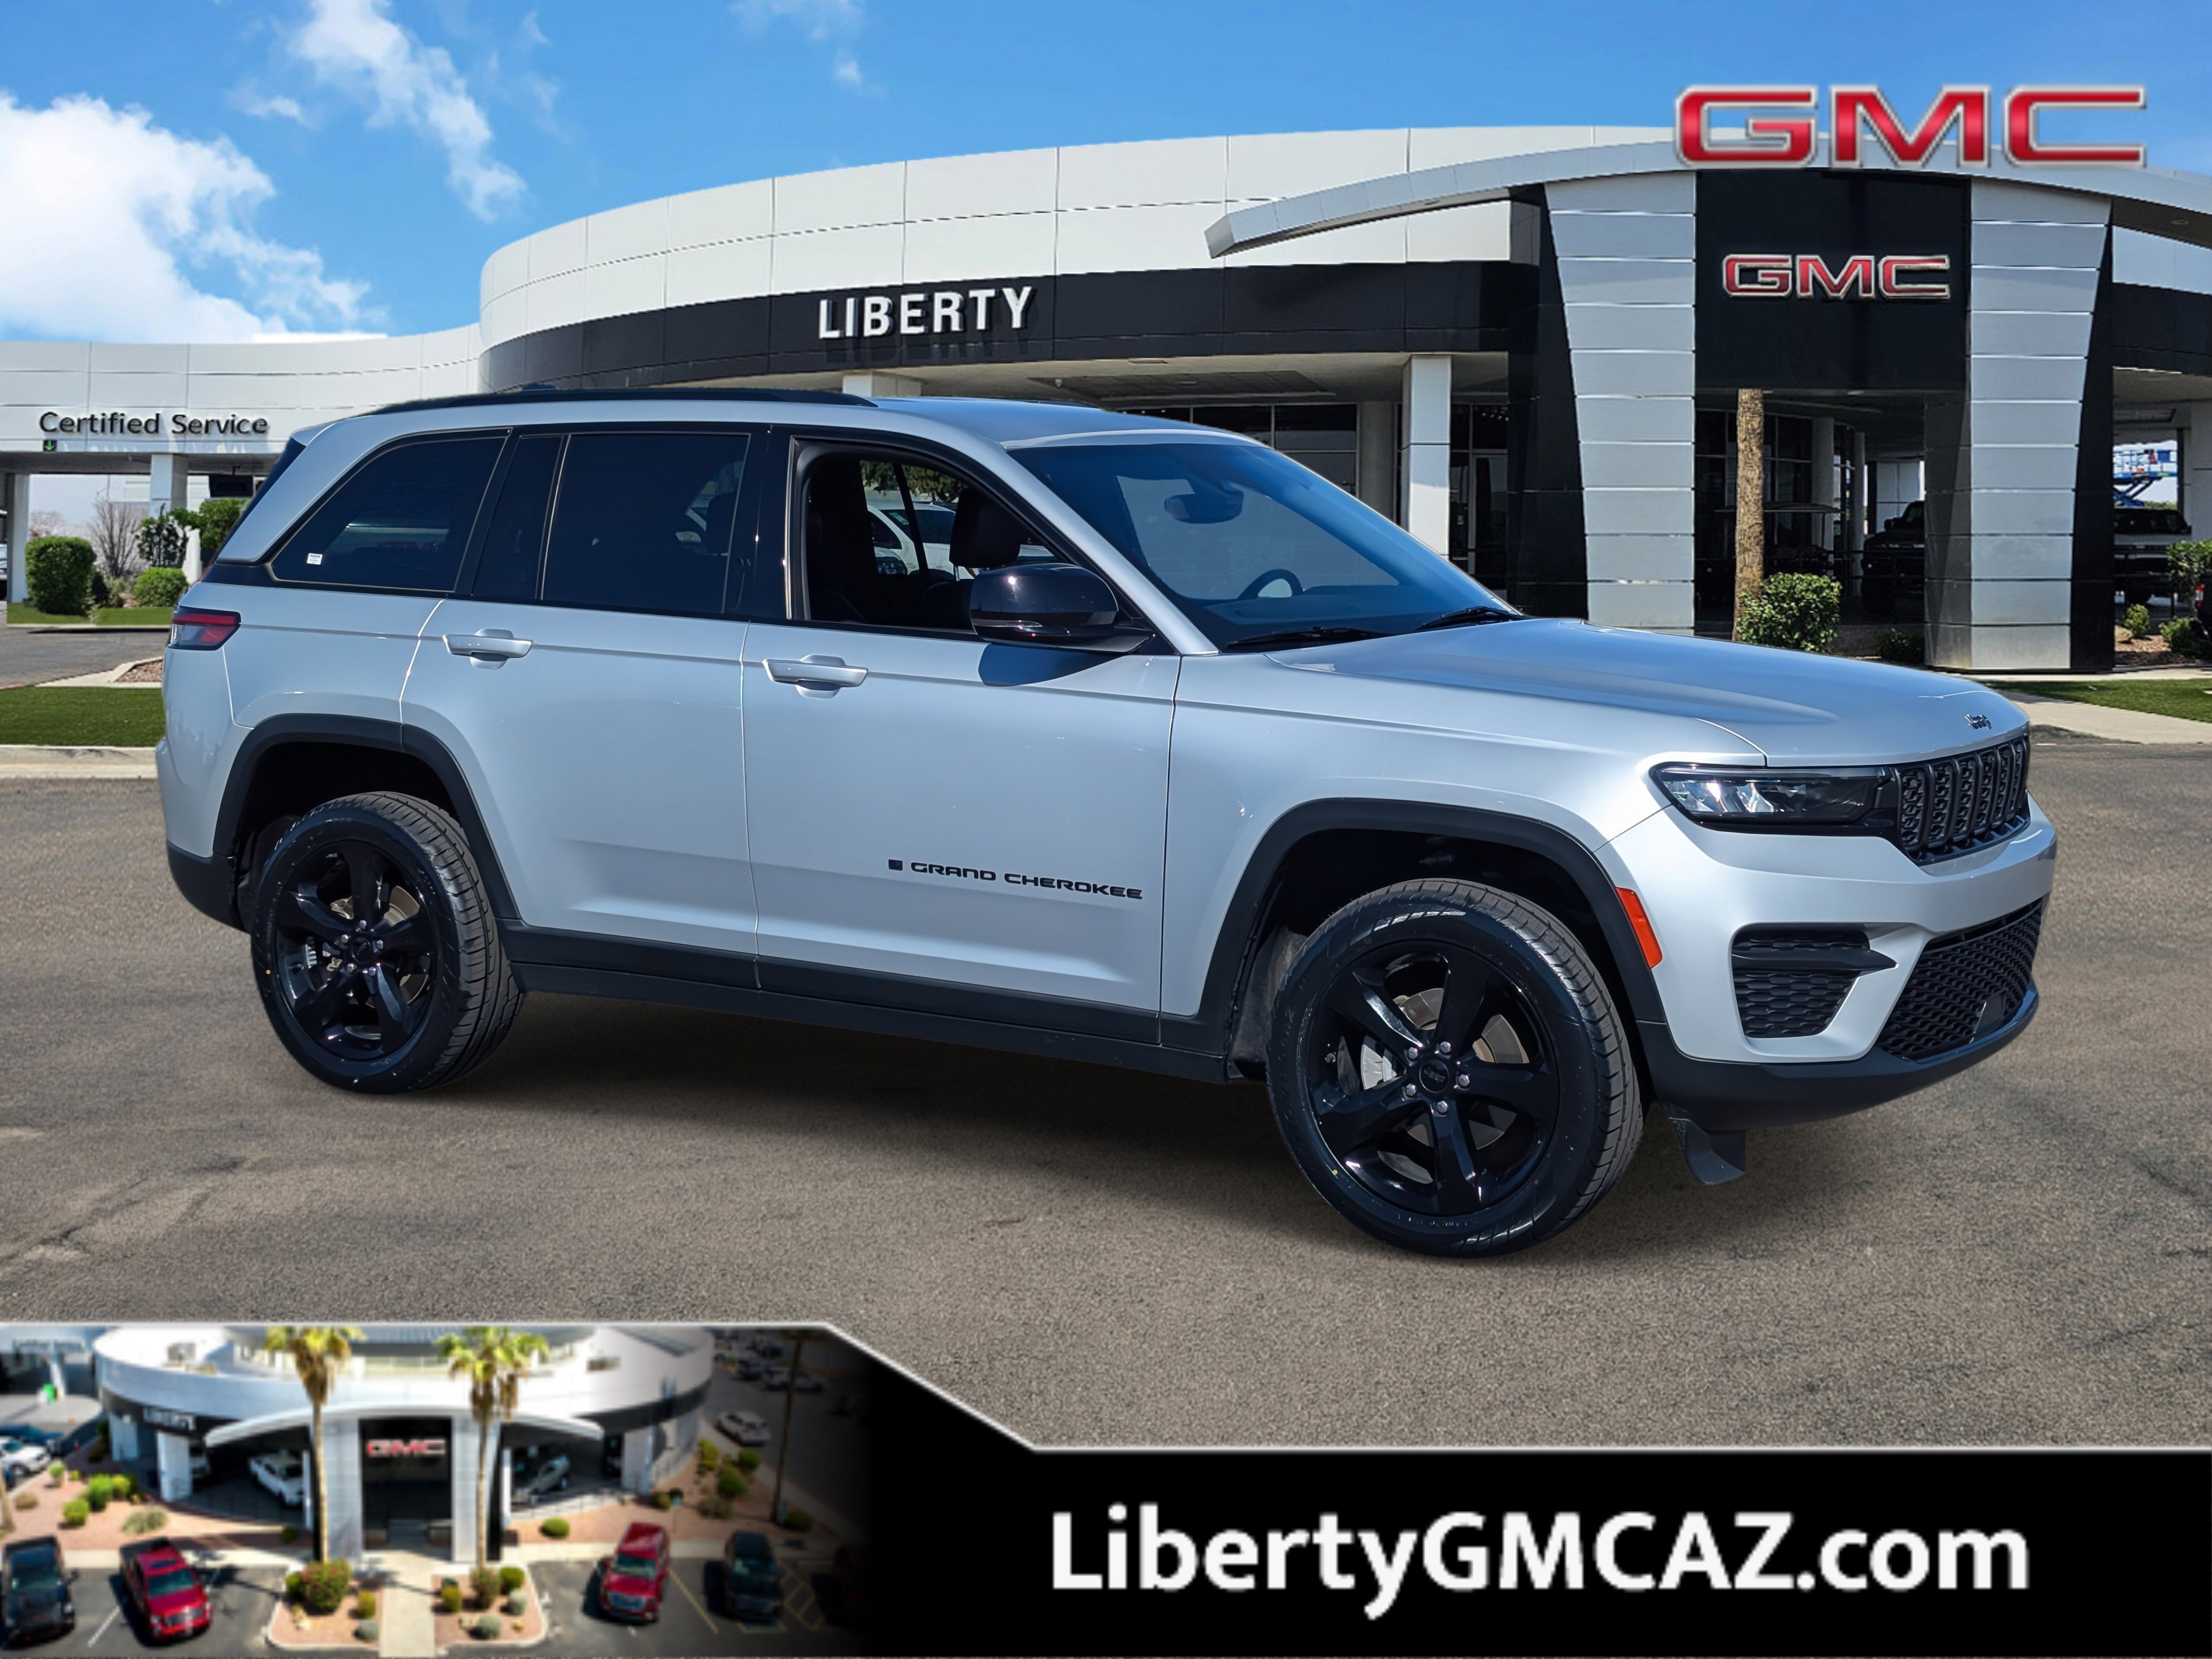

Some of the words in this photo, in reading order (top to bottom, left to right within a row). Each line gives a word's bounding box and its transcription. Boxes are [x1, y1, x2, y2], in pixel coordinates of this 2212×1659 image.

[1722, 254, 1950, 299] GMC
[819, 286, 1033, 339] LIBERTY
[39, 411, 160, 434] Certified
[171, 414, 268, 435] Service
[911, 862, 996, 881] GRAND
[1004, 873, 1143, 900] CHEROKEE
[367, 1439, 446, 1457] GMC
